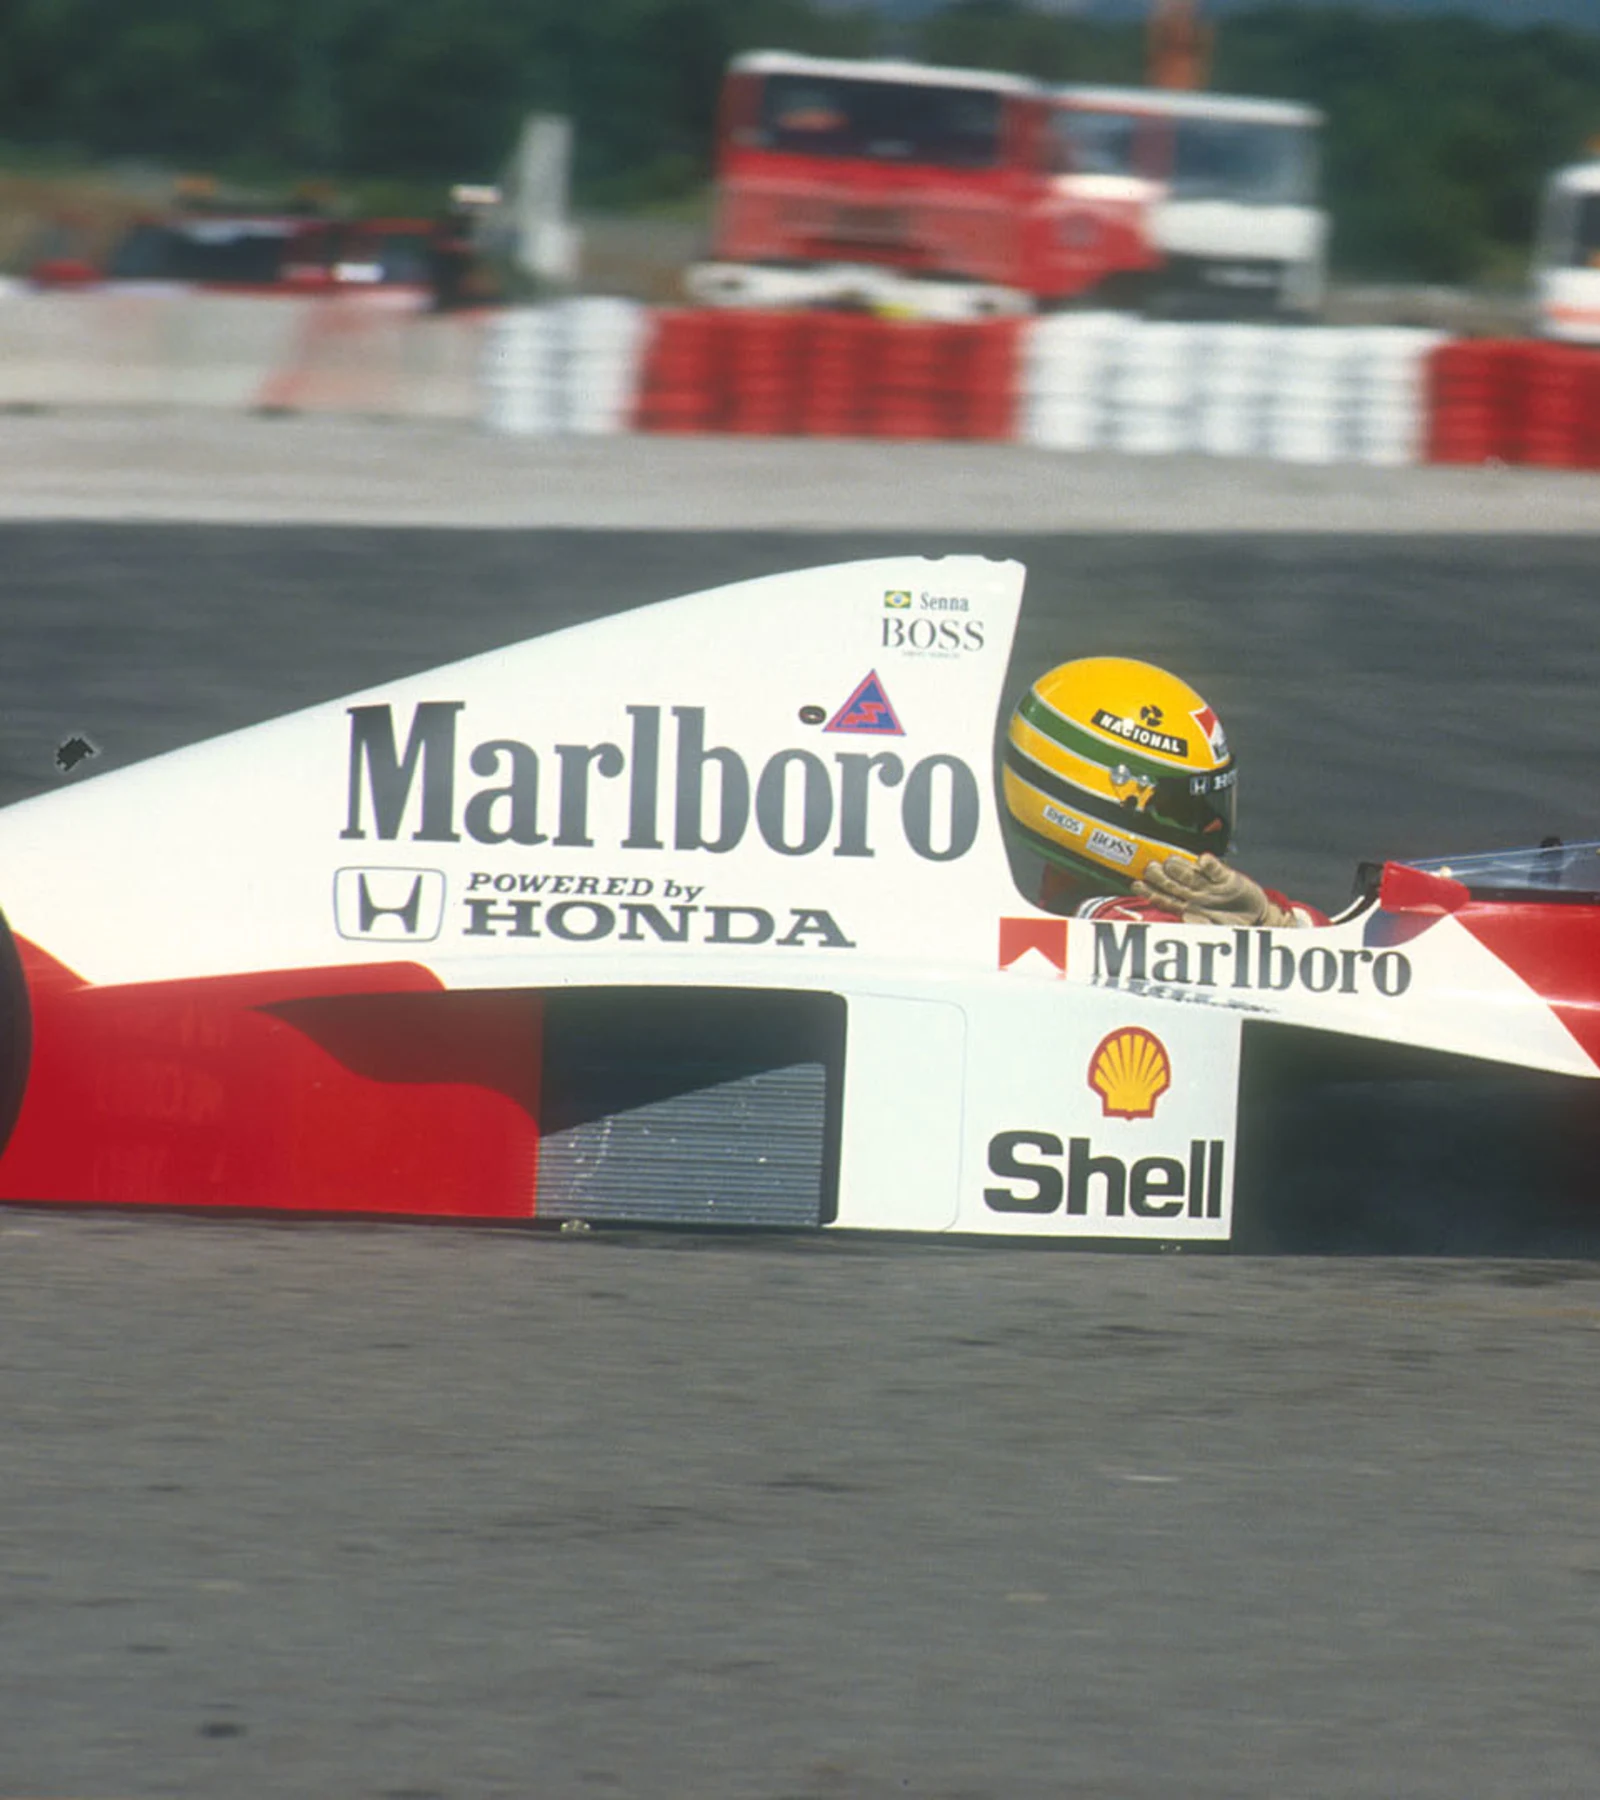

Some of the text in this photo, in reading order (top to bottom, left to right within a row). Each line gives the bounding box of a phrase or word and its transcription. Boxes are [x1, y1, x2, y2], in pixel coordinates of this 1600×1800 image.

[920, 592, 969, 612] Senna
[882, 617, 984, 652] BOSS
[1099, 714, 1181, 754] NACIONAL
[340, 701, 980, 861] Marlboro
[1091, 831, 1134, 857] BOSS
[466, 872, 705, 902] POWERED by
[463, 898, 857, 948] HONDA
[1091, 921, 1412, 997] Marlboro
[983, 1130, 1225, 1219] Shell
